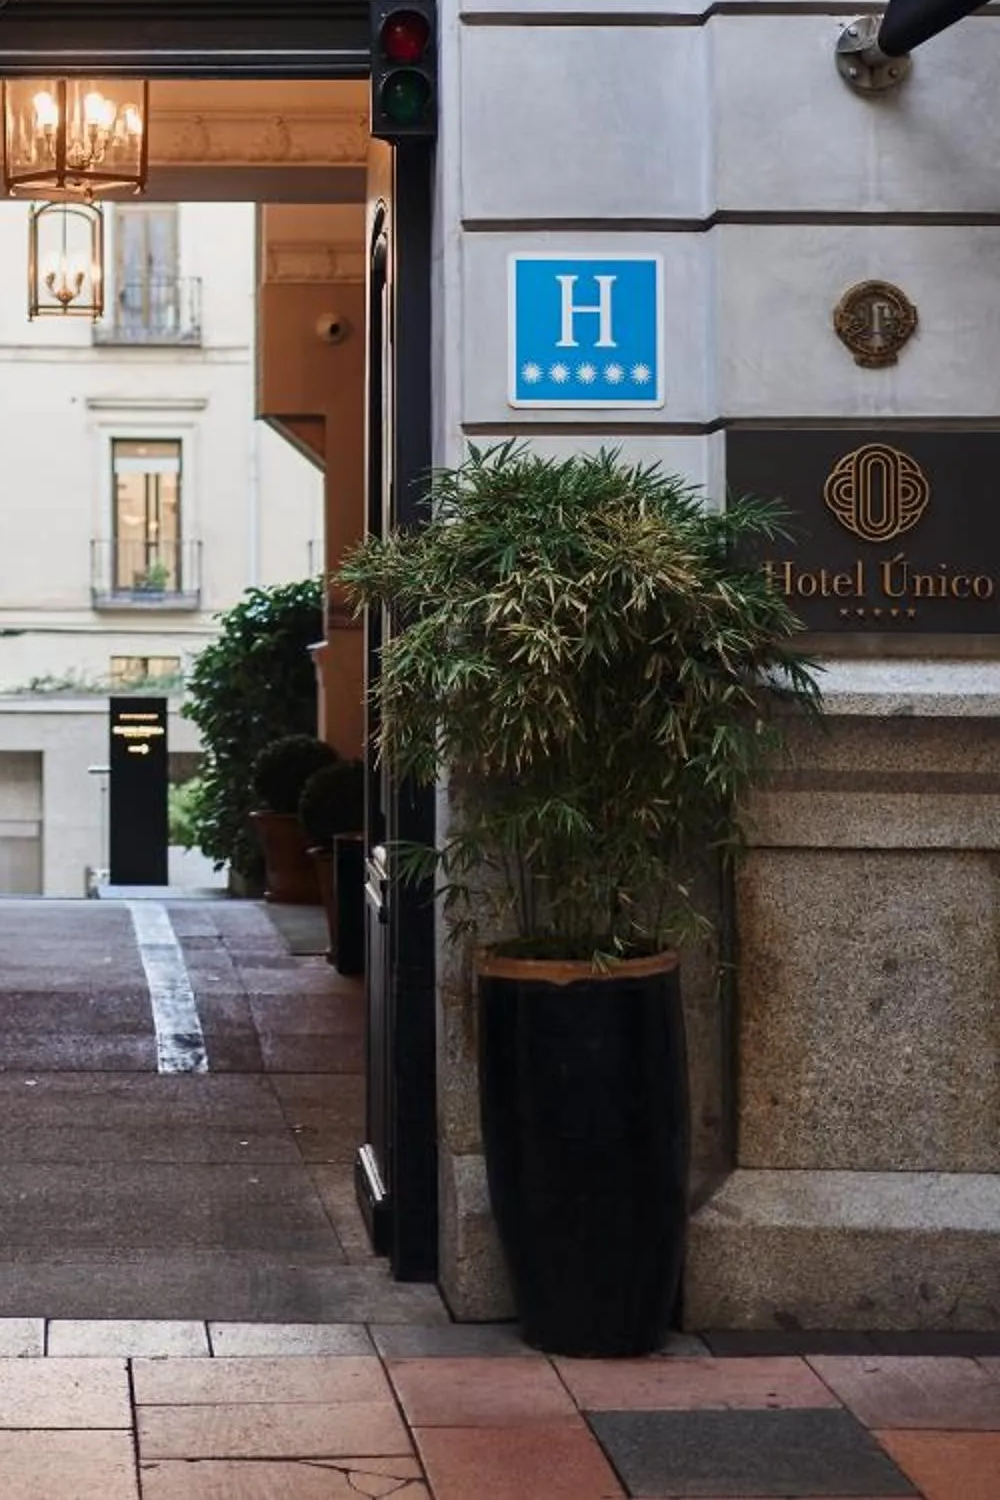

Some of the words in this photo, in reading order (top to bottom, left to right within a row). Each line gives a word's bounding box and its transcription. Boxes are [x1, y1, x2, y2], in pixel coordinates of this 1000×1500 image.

[554, 274, 618, 348] H
[762, 559, 866, 597] Hotel
[880, 552, 994, 598] Único
